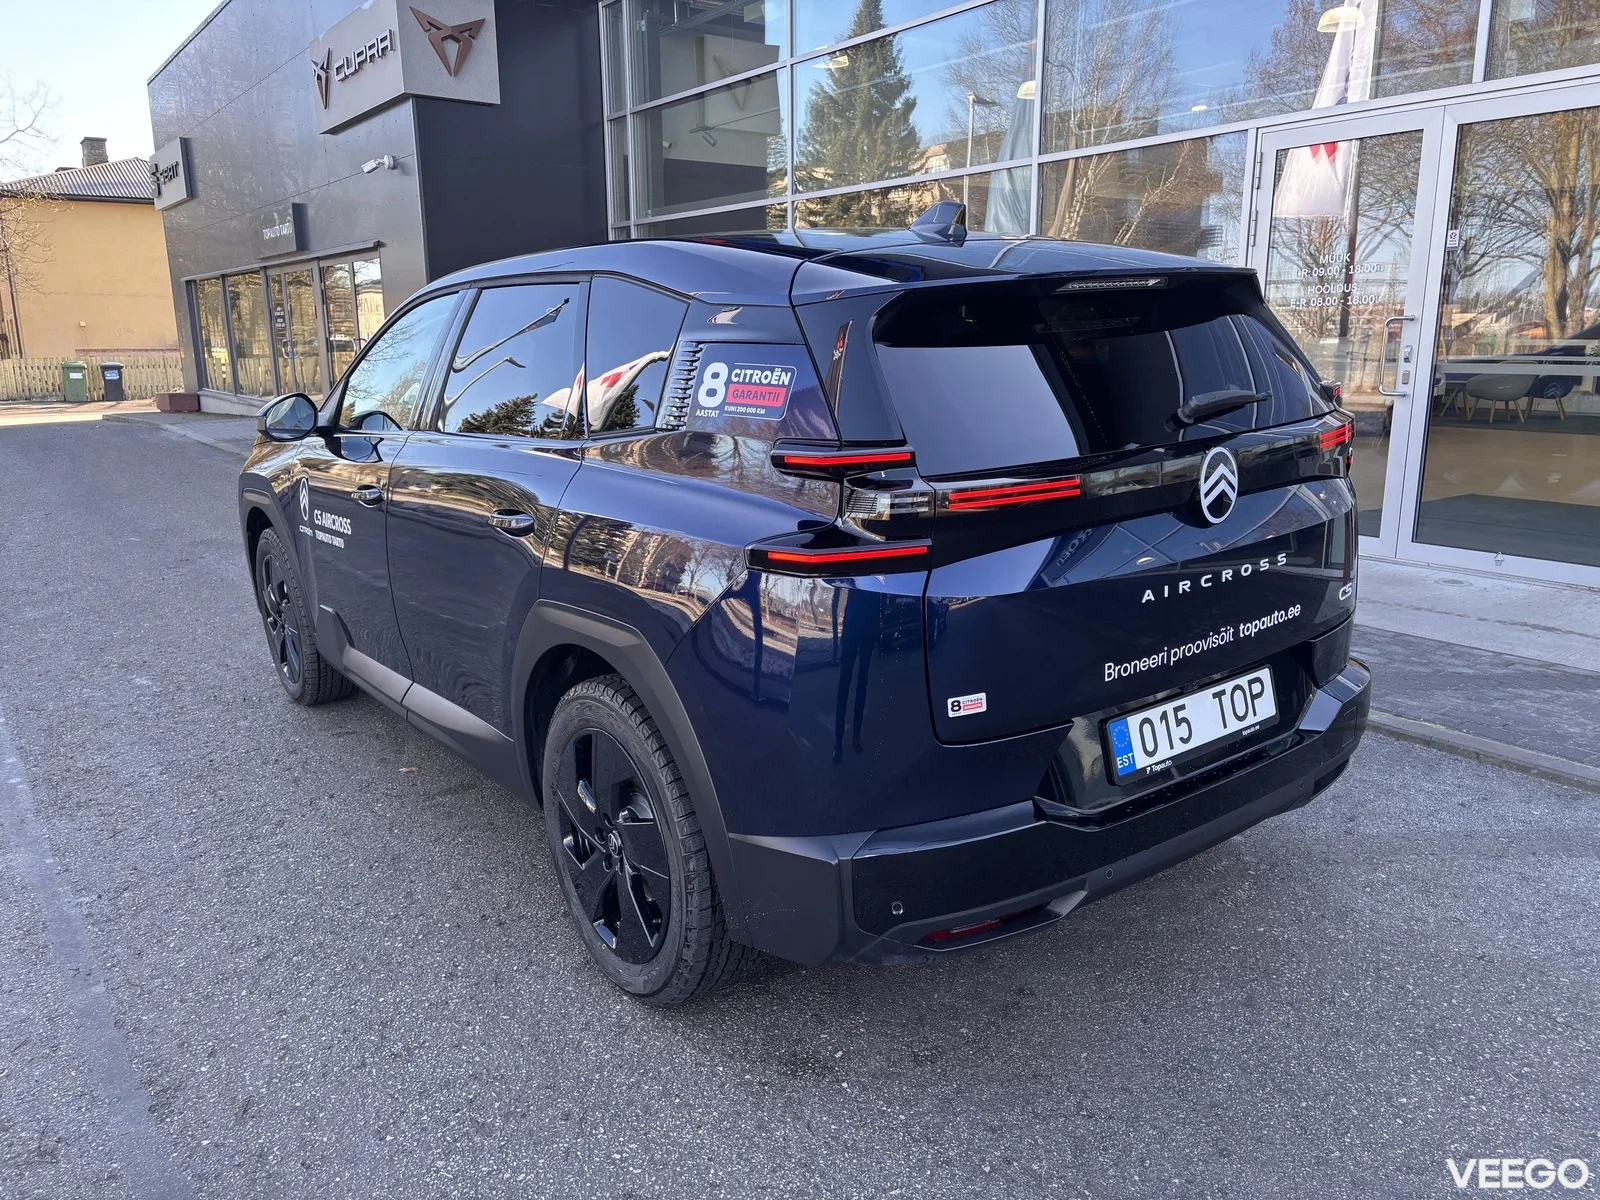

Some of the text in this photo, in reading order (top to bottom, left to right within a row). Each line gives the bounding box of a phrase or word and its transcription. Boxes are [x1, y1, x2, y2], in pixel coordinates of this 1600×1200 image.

[333, 28, 395, 82] CUPRA
[1312, 265, 1340, 277] 09.00
[1348, 263, 1378, 275] 18.00
[1308, 283, 1358, 294] HOOLDUS
[1310, 296, 1338, 307] 08.00
[1347, 294, 1375, 305] 18.00
[697, 362, 729, 408] 8
[731, 368, 791, 386] CITROËN
[732, 388, 780, 403] GARANTII
[695, 409, 720, 418] AASTAT
[314, 509, 352, 535] C5 AIRCROSS
[1141, 553, 1287, 604] AIRCROSS
[1339, 582, 1353, 601] C5
[1104, 603, 1302, 682] Broneeri proovisõit topauto.ee
[950, 700, 961, 712] 8
[1138, 676, 1265, 758] 015 TOP
[1117, 752, 1135, 769] EST
[1151, 760, 1173, 773] Topauto
